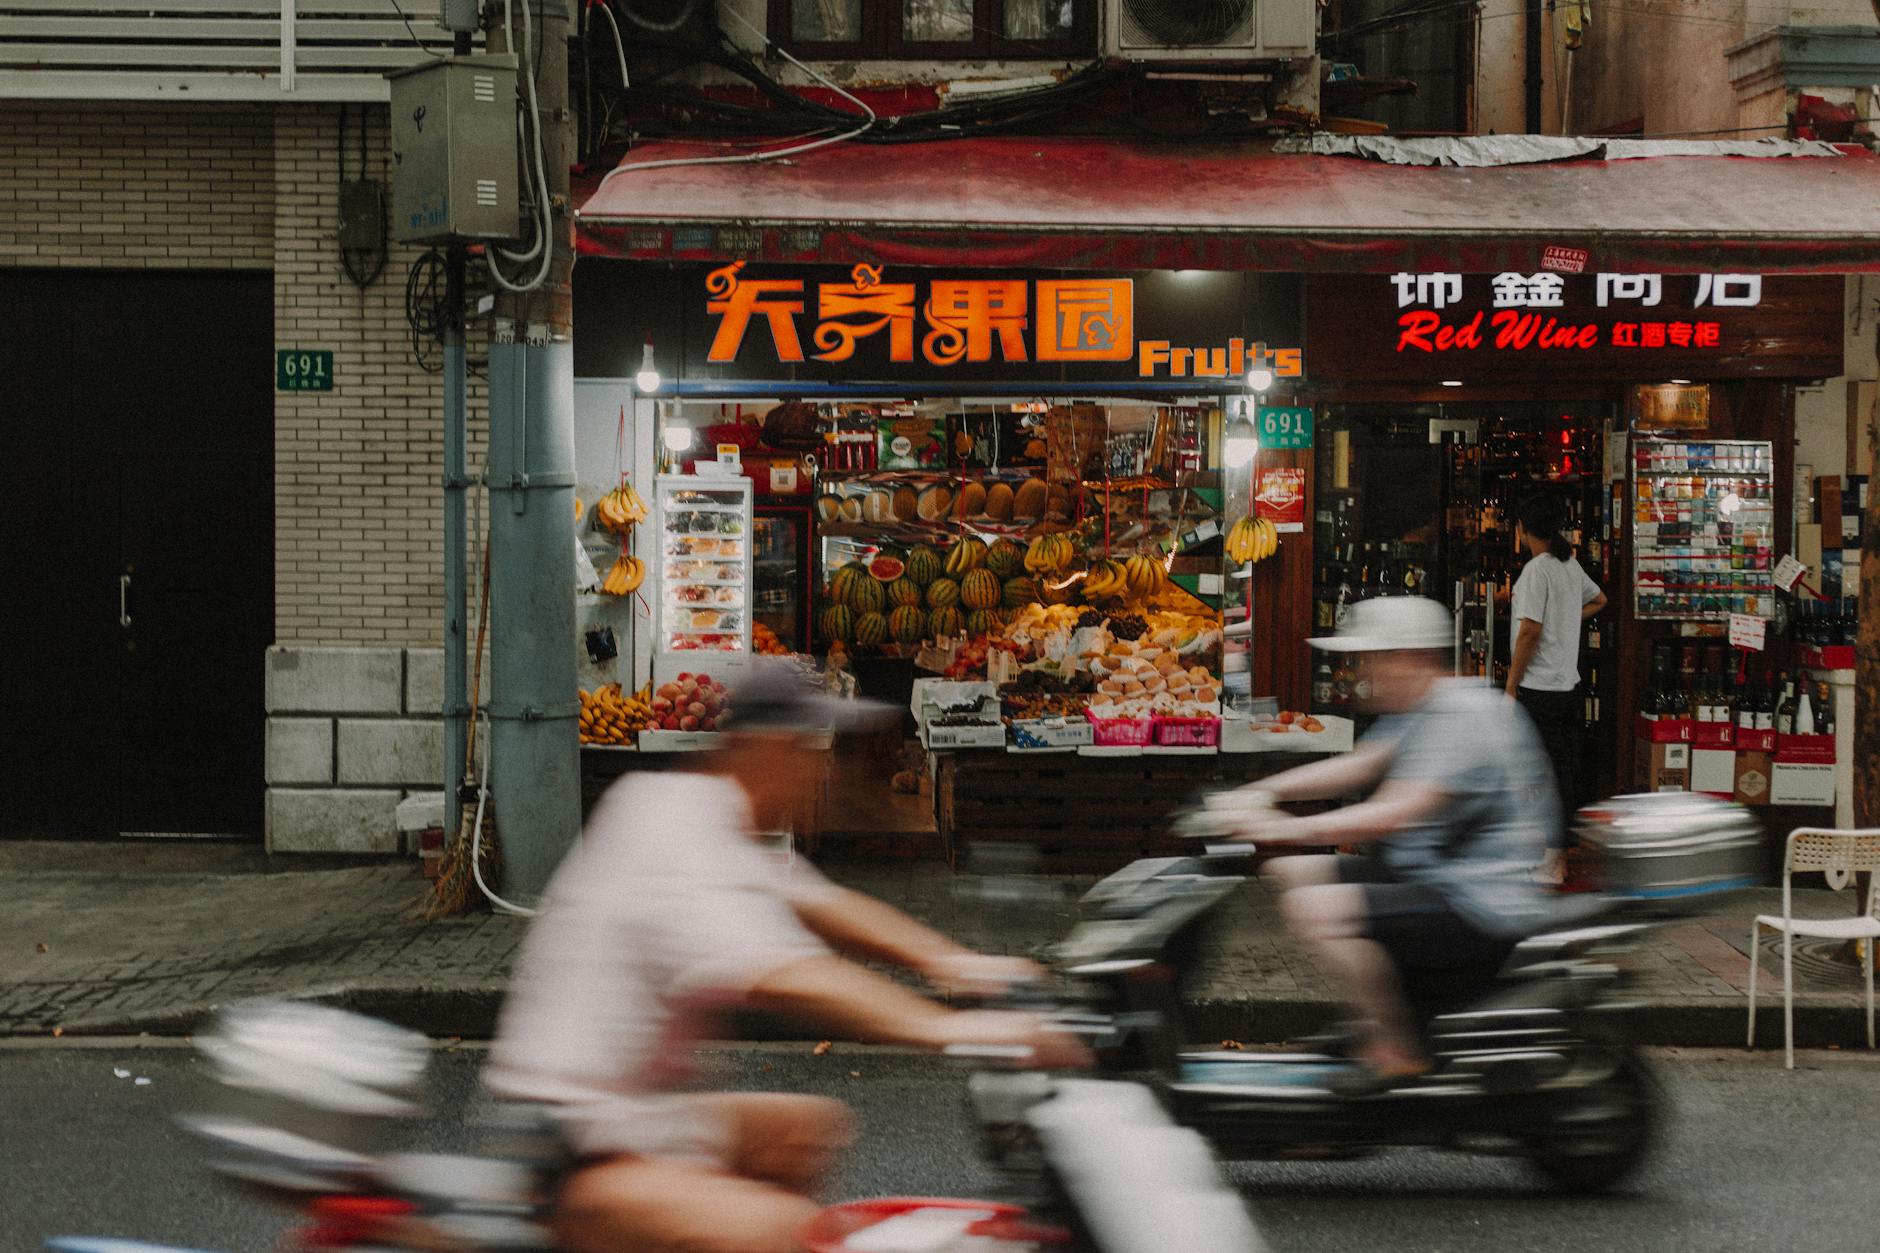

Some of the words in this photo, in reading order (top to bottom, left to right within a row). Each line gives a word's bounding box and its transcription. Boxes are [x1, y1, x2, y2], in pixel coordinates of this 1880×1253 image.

[705, 260, 1134, 367] 天齐果园
[1396, 310, 1484, 353] Red
[1490, 310, 1598, 352] Wine
[1612, 321, 1721, 348] 红酒专柜
[285, 354, 325, 377] 691
[1138, 338, 1302, 377] Fruits
[1265, 412, 1305, 434] 691
